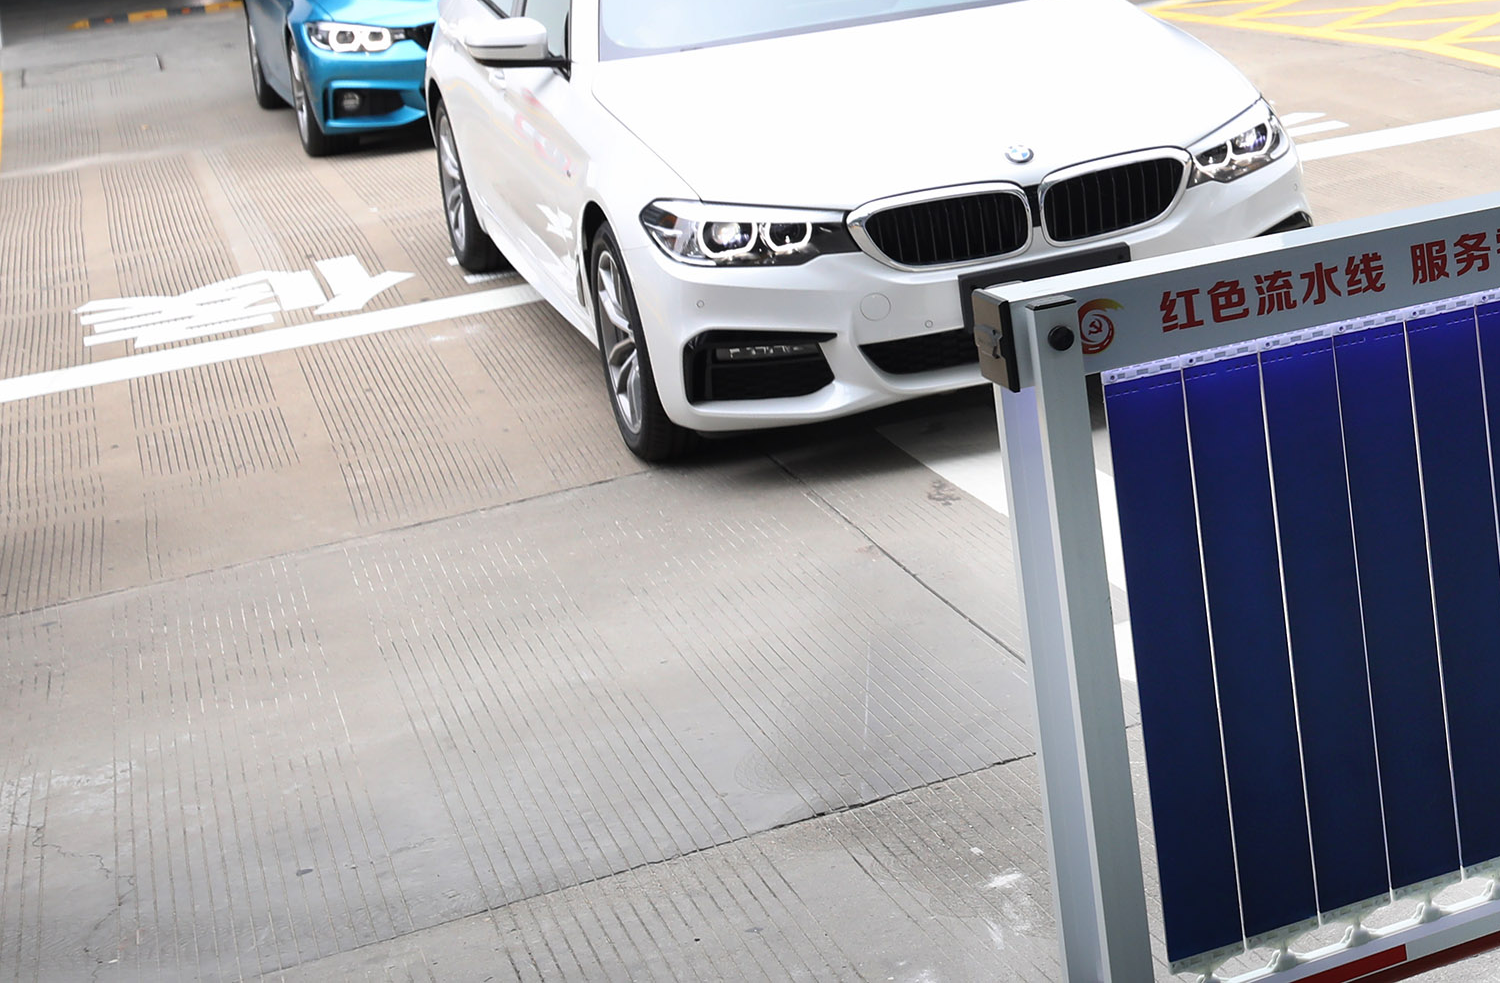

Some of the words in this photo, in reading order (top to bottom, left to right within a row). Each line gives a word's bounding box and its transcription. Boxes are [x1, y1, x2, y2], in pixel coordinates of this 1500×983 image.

[1159, 251, 1387, 334] 红色流水线
